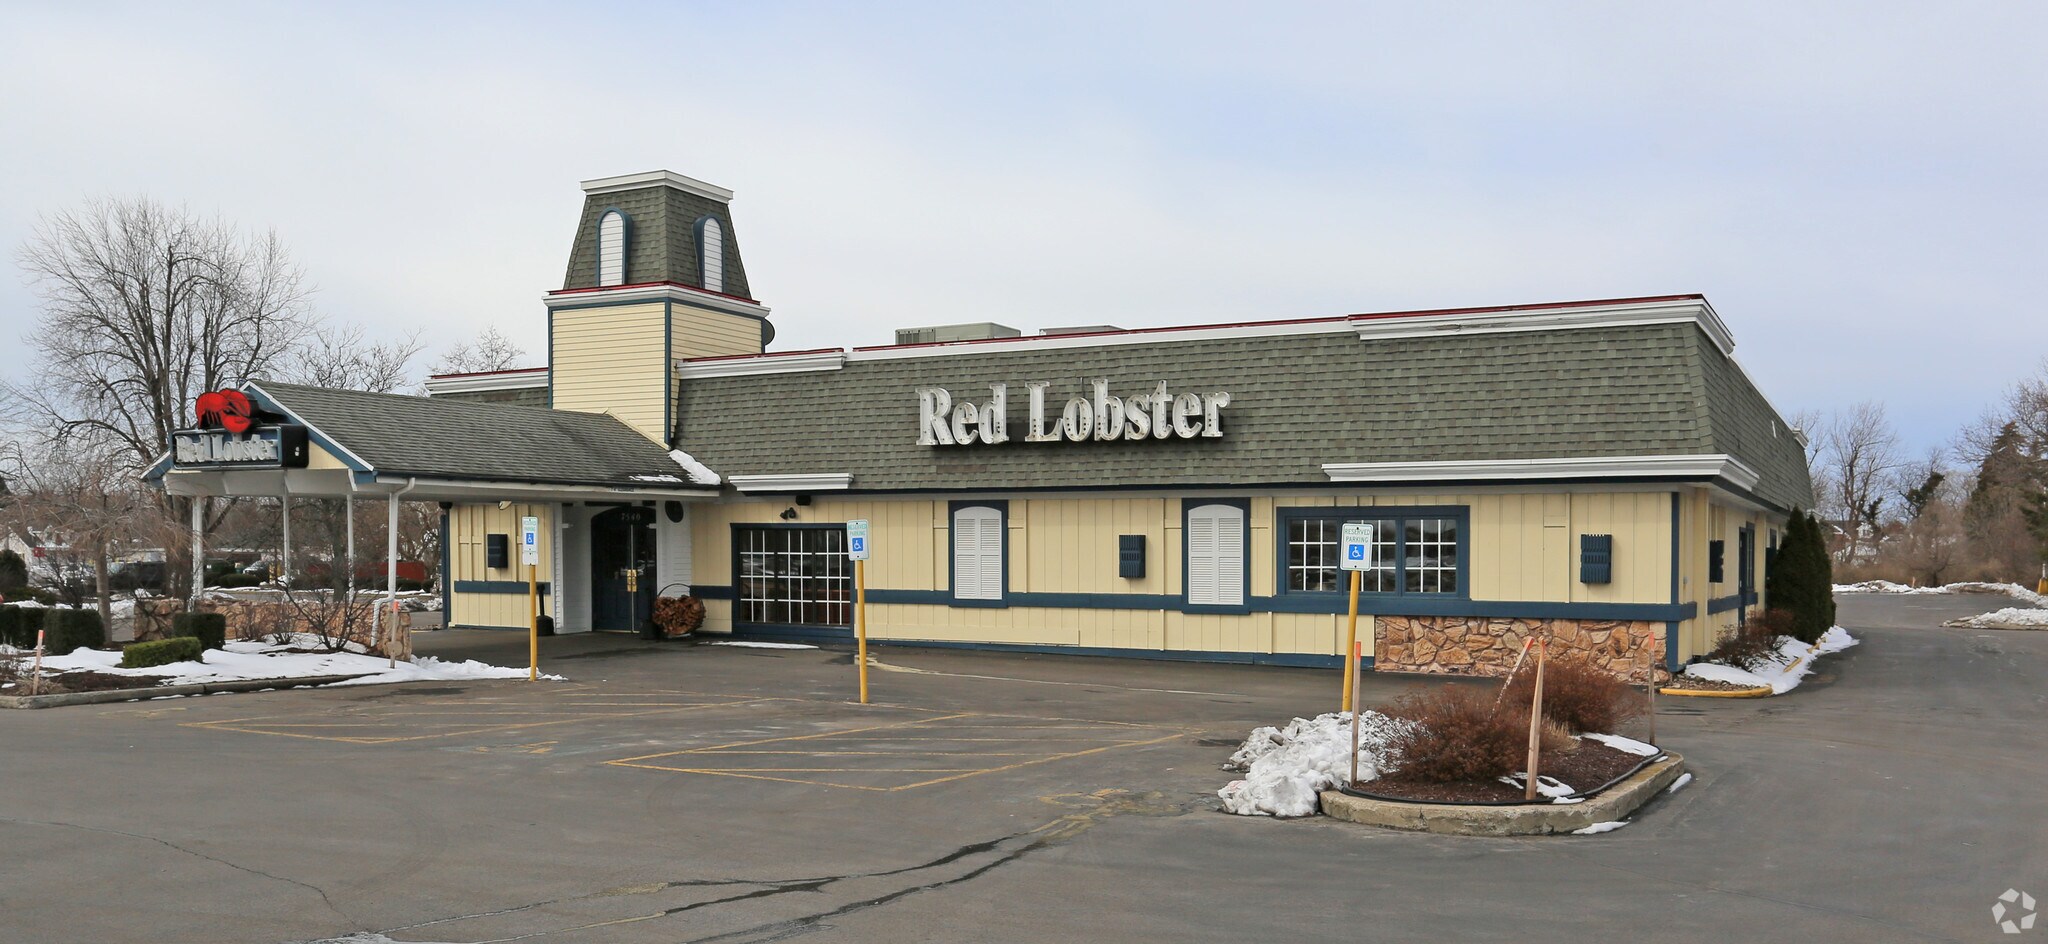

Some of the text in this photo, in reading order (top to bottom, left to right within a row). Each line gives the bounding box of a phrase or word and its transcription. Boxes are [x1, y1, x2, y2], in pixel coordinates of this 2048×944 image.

[914, 378, 1231, 446] Red Lobster
[174, 433, 278, 463] Red Lobster
[1344, 528, 1370, 536] RESERVED
